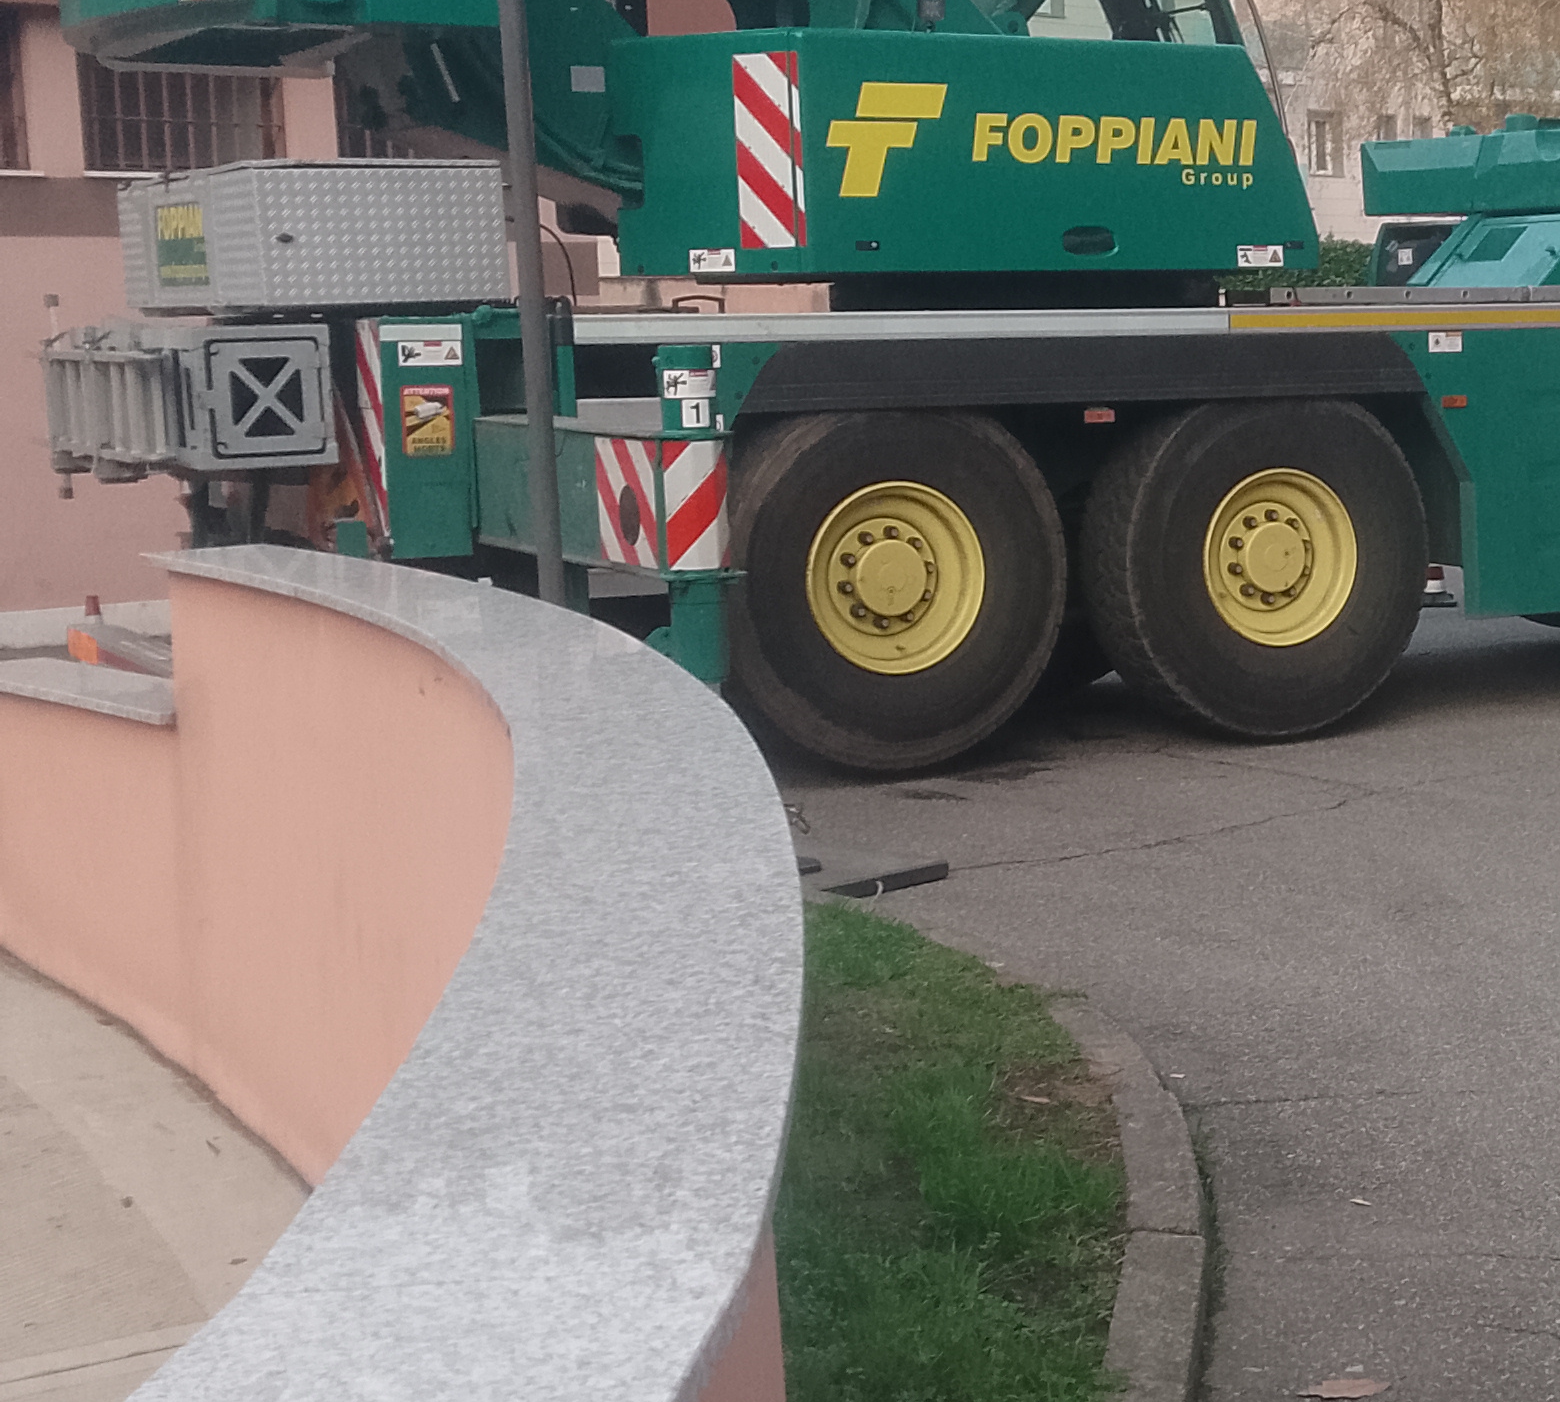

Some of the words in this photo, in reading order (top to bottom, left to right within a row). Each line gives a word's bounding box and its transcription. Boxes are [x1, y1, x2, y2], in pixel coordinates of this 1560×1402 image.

[972, 112, 1257, 166] FOPPIANI
[1181, 168, 1254, 190] Group
[690, 401, 701, 424] 1
